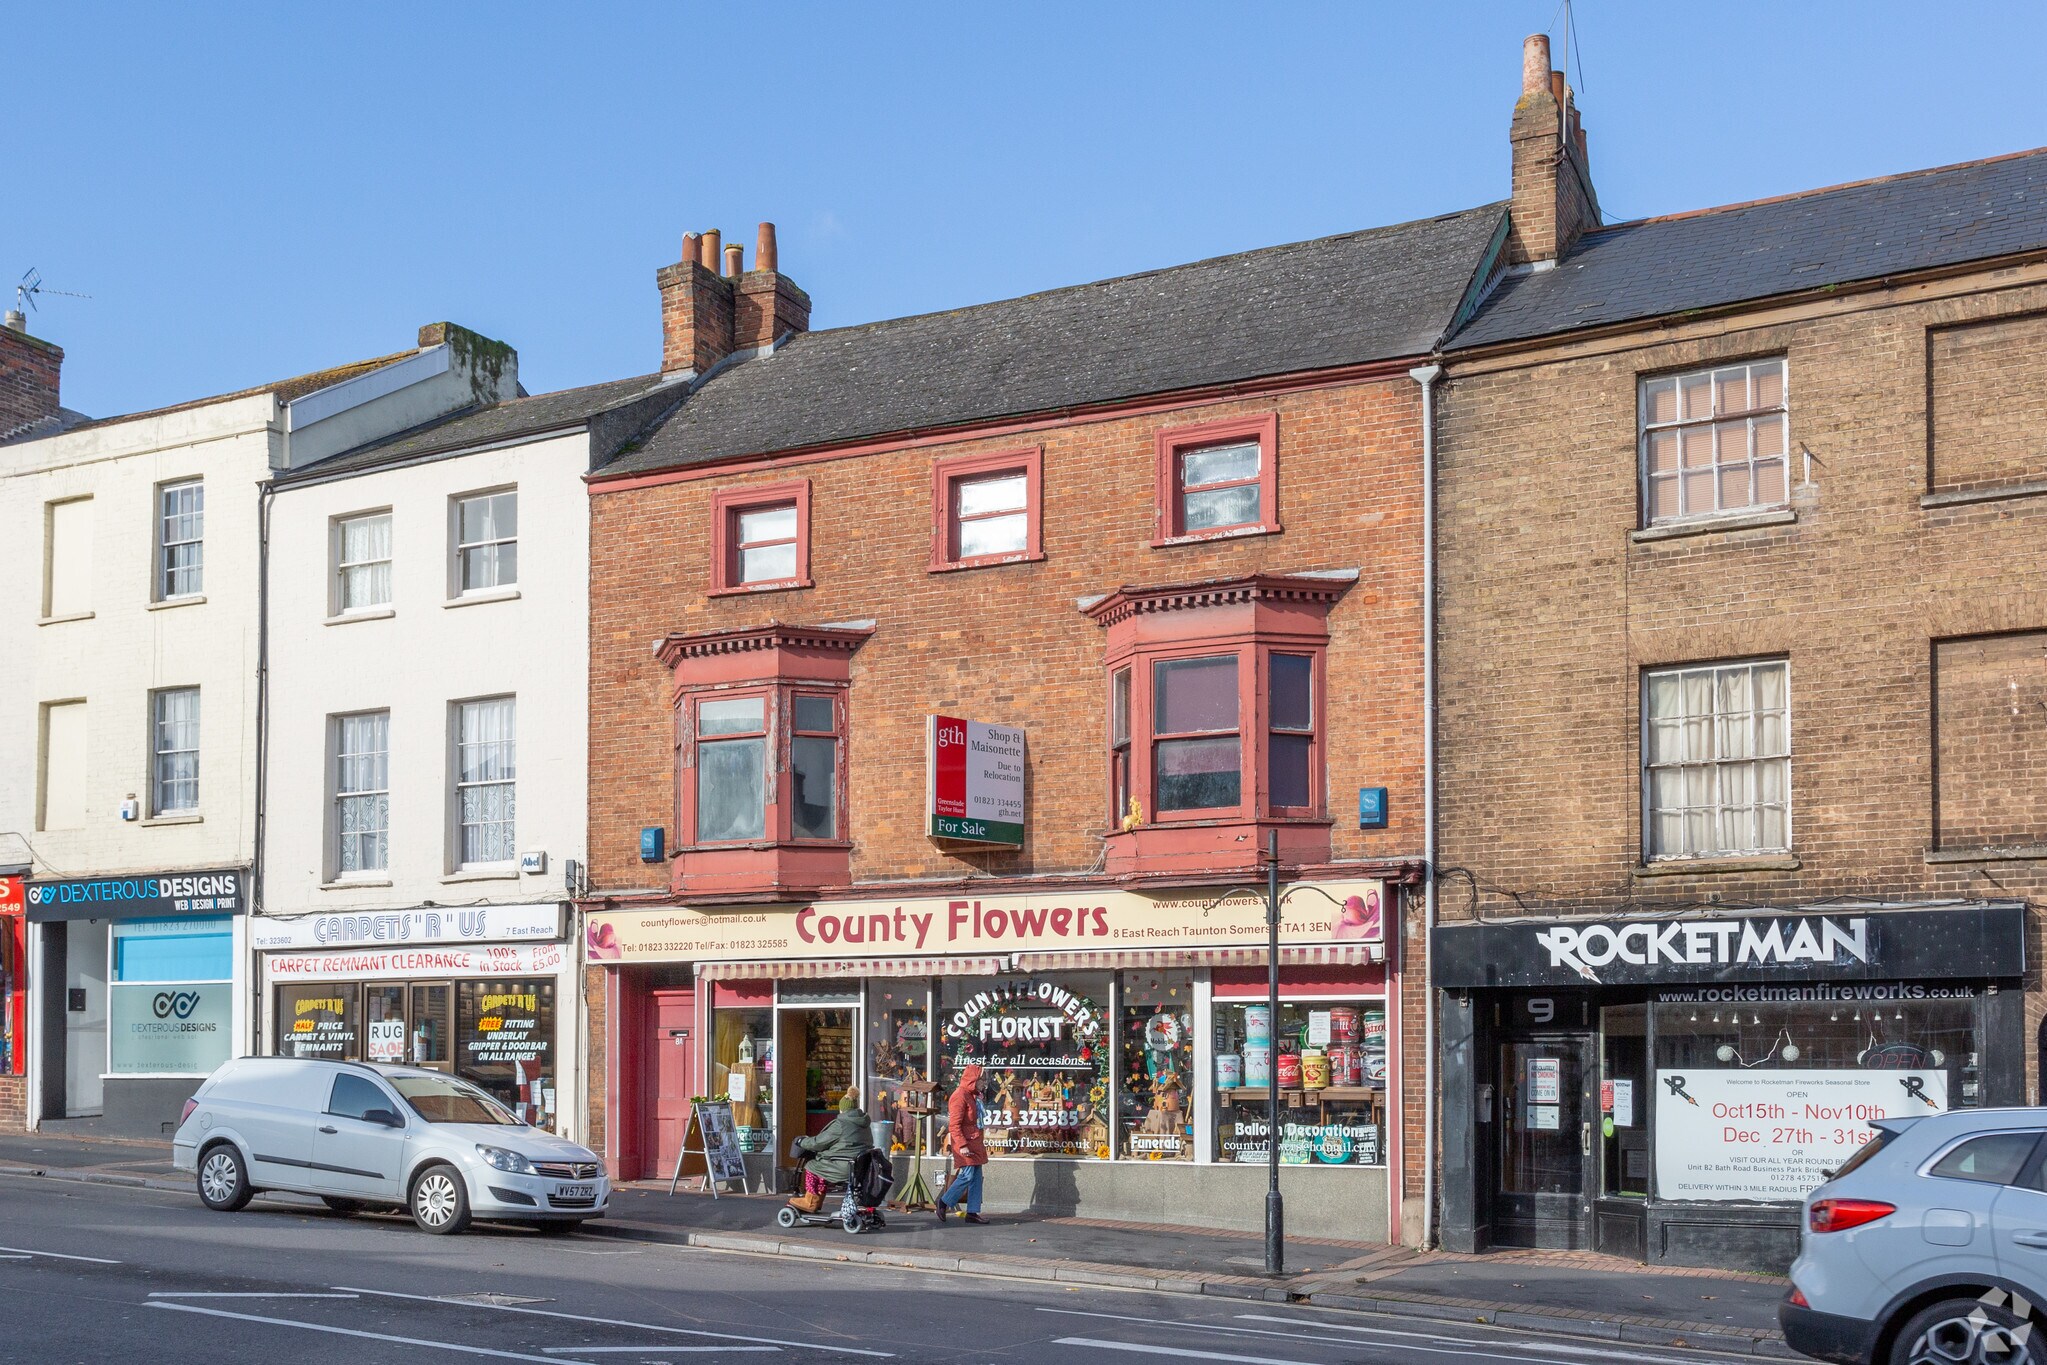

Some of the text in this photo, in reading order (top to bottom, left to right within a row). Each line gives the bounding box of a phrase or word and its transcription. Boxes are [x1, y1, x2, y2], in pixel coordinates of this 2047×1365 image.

[938, 725, 965, 747] gth
[988, 729, 1011, 744] Shop
[971, 740, 1020, 757] Maisonette
[997, 761, 1020, 772] Due to
[984, 770, 1020, 782] Relocation
[974, 795, 1022, 808] 01823 334455
[998, 808, 1021, 818] gth.net
[938, 818, 985, 836] For Sale
[175, 897, 236, 911] WEB DESIGN PRINT
[314, 914, 411, 942] CARPETS
[459, 910, 486, 937] US
[641, 914, 767, 928] countyflowers@hotmail.co.uk
[795, 900, 1109, 950] County Flowers
[512, 927, 528, 935] East
[531, 926, 553, 934] Reach
[1113, 922, 1332, 938] 8 East Reach Taunton Somerst TA1 3EN
[256, 937, 267, 945] Tel:
[622, 939, 788, 953] Tel: 01823 332220 Tel/Fax: 01823 325585
[486, 947, 517, 959] 100's
[532, 943, 556, 958] From
[1536, 918, 1867, 980] ROCKETMAN
[272, 952, 470, 973] CARPET REMNANT CLEARANCE
[493, 959, 522, 972] Stock
[1658, 981, 1975, 1003] www.rocketmanfireworks.co.uk
[1527, 998, 1555, 1024] 9
[295, 1022, 344, 1030] HALF PRICE
[481, 1019, 535, 1029] FREE FITTING
[979, 1016, 1064, 1043] FLORIST
[284, 1032, 355, 1041] CARPET & VINYL
[371, 1025, 403, 1039] RUG
[486, 1032, 529, 1041] UNDERLAY
[369, 1041, 404, 1056] SALE
[468, 1042, 501, 1051] GRIPPER
[504, 1052, 537, 1061] RANGES
[953, 1054, 987, 1066] finest
[990, 1054, 1006, 1066] for
[1010, 1054, 1026, 1066] all
[1867, 1053, 1929, 1069] OPEN
[983, 1109, 1079, 1127] 823 325585
[1712, 1102, 1785, 1119] Oct15th
[1805, 1104, 1885, 1120] Nov10th
[1287, 1122, 1364, 1138] Decorations
[1724, 1127, 1761, 1142] Dec
[1773, 1128, 1813, 1143] 27th
[1833, 1128, 1874, 1144] 31st
[1131, 1136, 1180, 1150] Funerals
[1223, 1139, 1376, 1153] countyflwers@hotmail.com
[1782, 1157, 1804, 1165] YEAR
[1769, 1185, 1798, 1193] RADIUS
